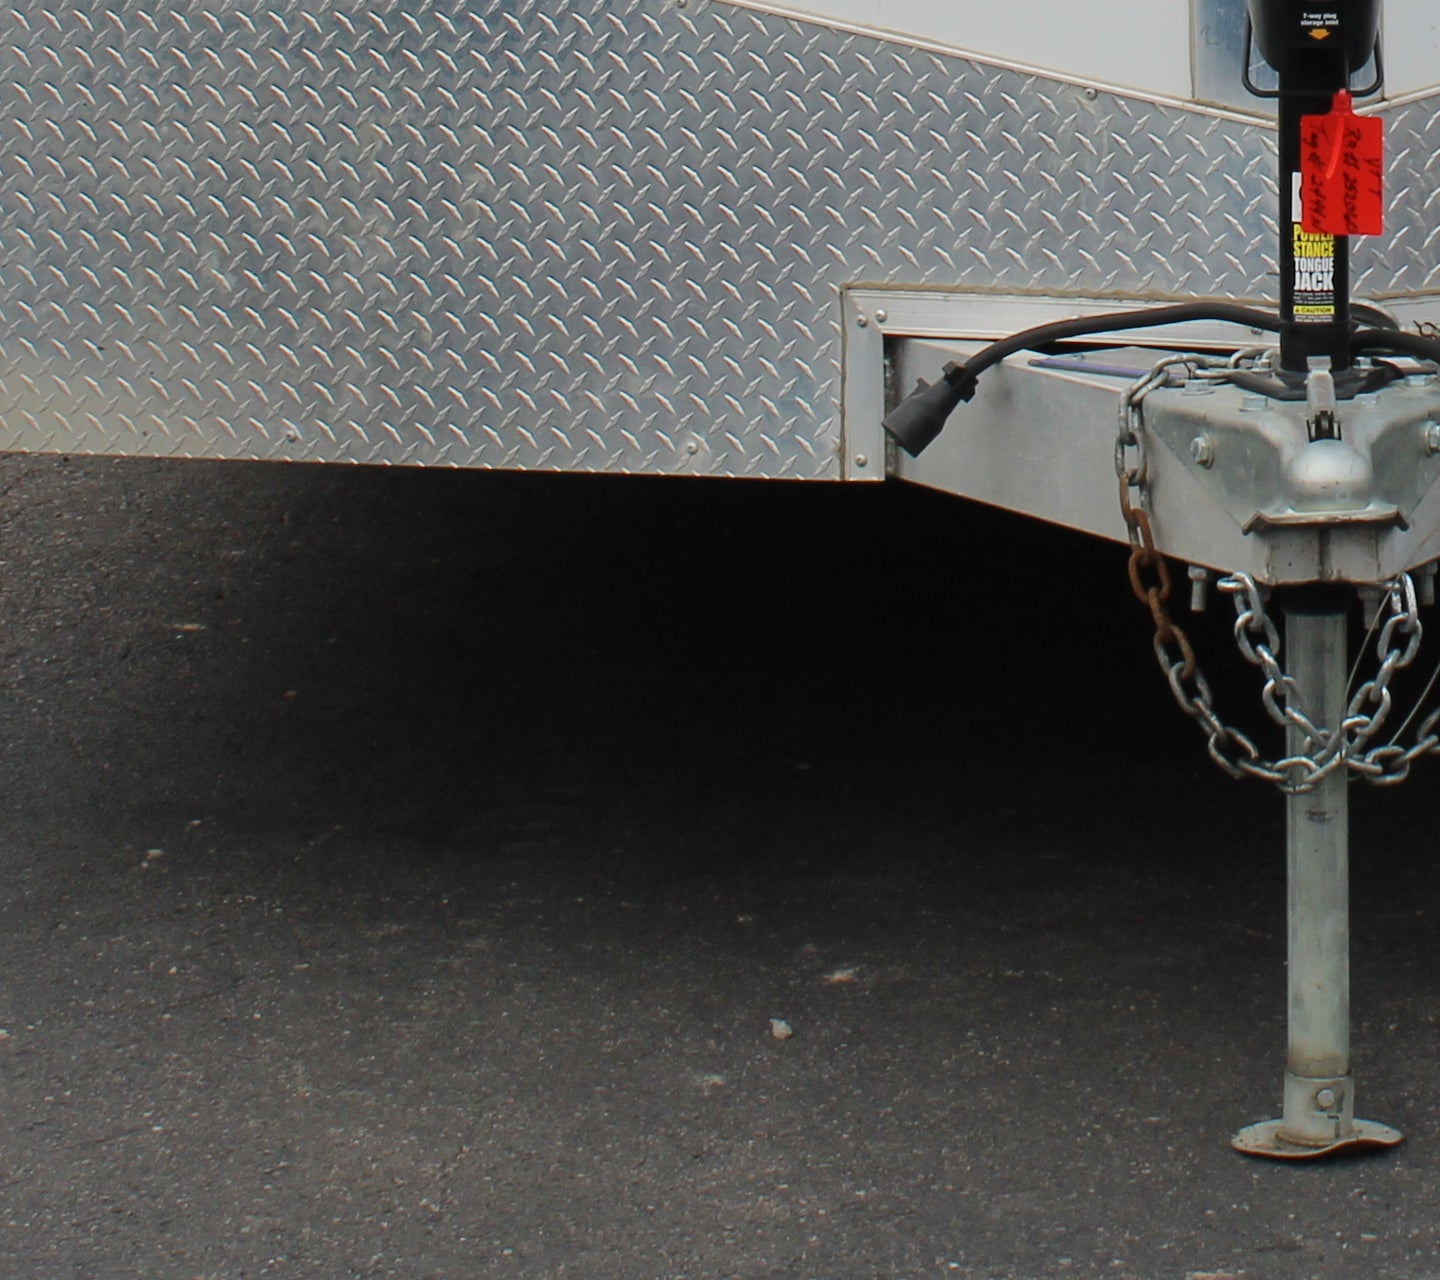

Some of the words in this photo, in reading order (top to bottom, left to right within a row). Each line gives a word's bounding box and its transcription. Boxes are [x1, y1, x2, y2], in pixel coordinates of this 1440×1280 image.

[1294, 242, 1335, 257] STANCE
[1294, 257, 1335, 272] TONGUE
[1294, 272, 1335, 291] JACK
[1300, 306, 1332, 314] CAUTION
